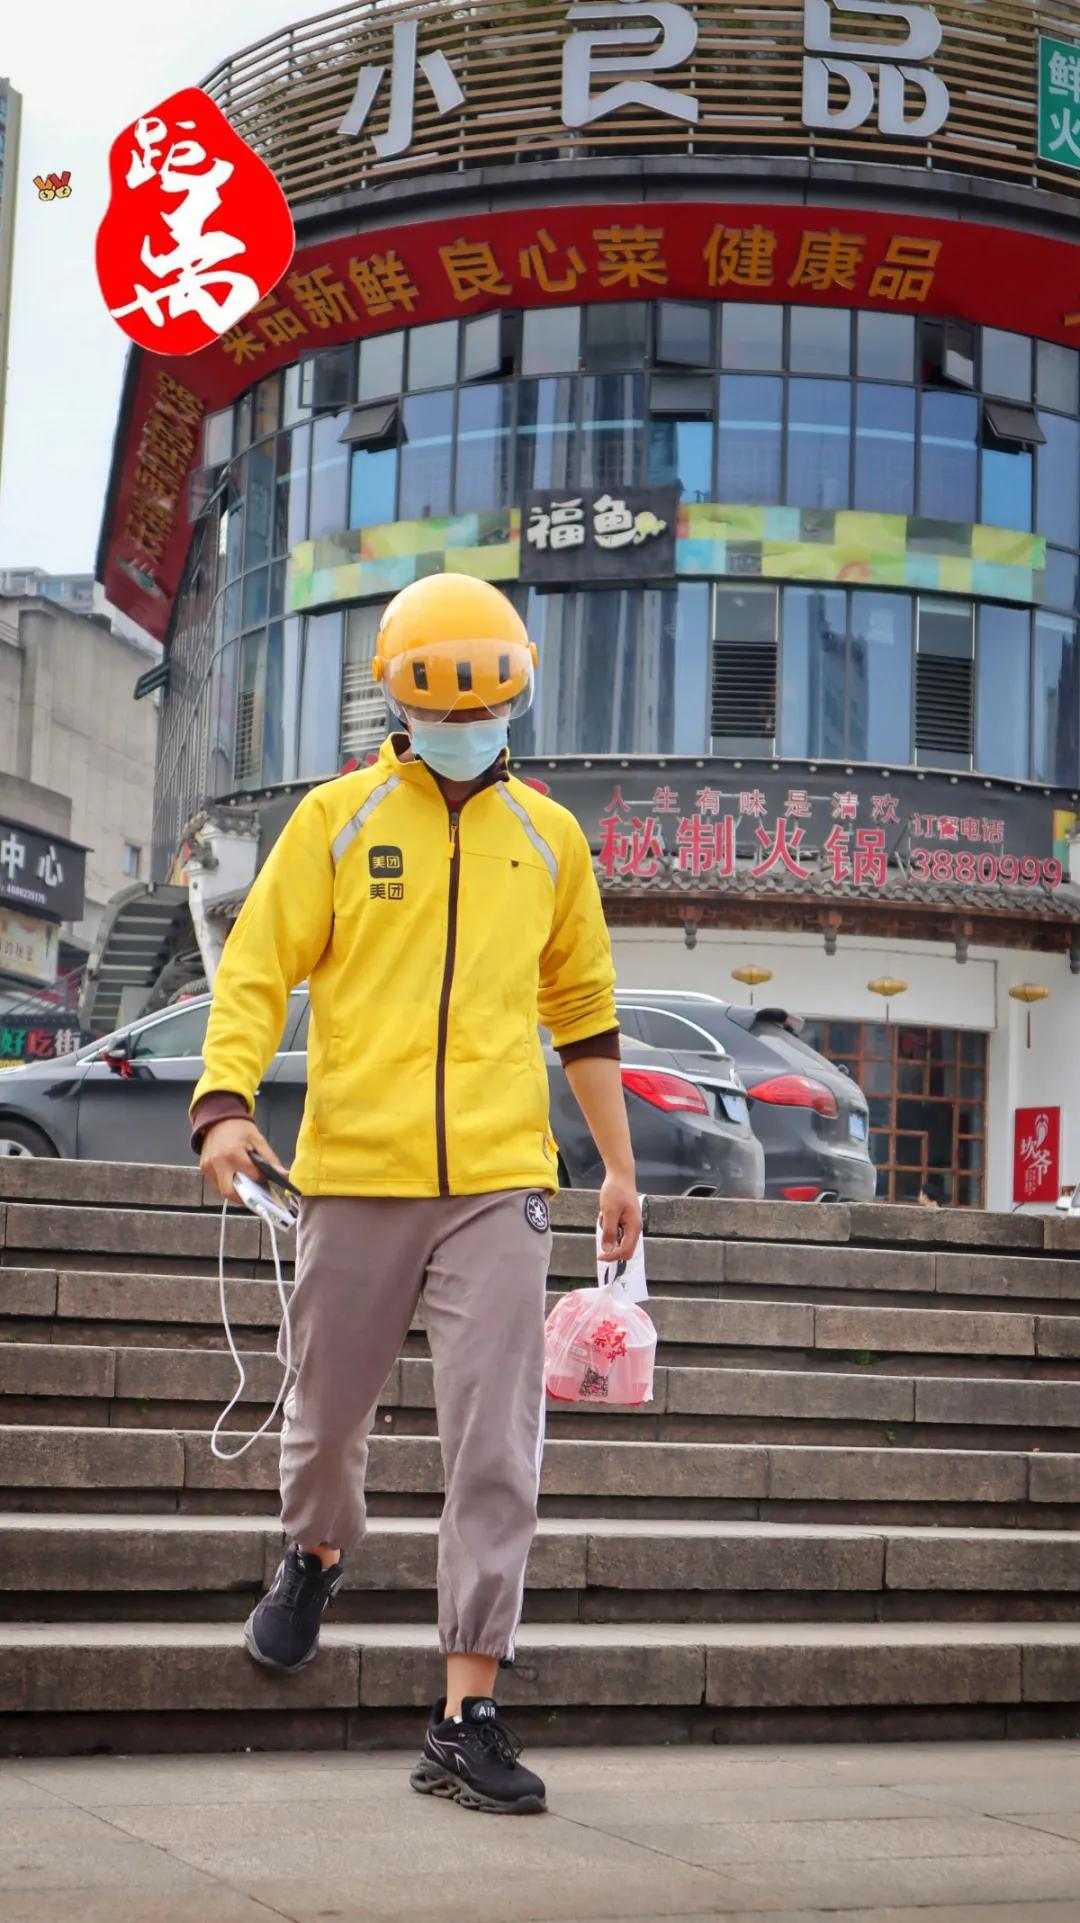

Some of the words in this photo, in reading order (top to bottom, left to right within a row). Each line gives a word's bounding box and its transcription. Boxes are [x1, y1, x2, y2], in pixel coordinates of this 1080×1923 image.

[438, 225, 669, 302] 良心菜
[704, 224, 943, 302] 健康品
[604, 784, 900, 824] 人生有味是清欢
[912, 812, 1006, 844] 订餐电话
[0, 833, 63, 887] 中心
[371, 855, 401, 869] 美团
[599, 813, 889, 888] 秘制火锅
[910, 847, 1063, 891] 3880999
[369, 882, 404, 900] 美团
[478, 1706, 496, 1718] AIR
